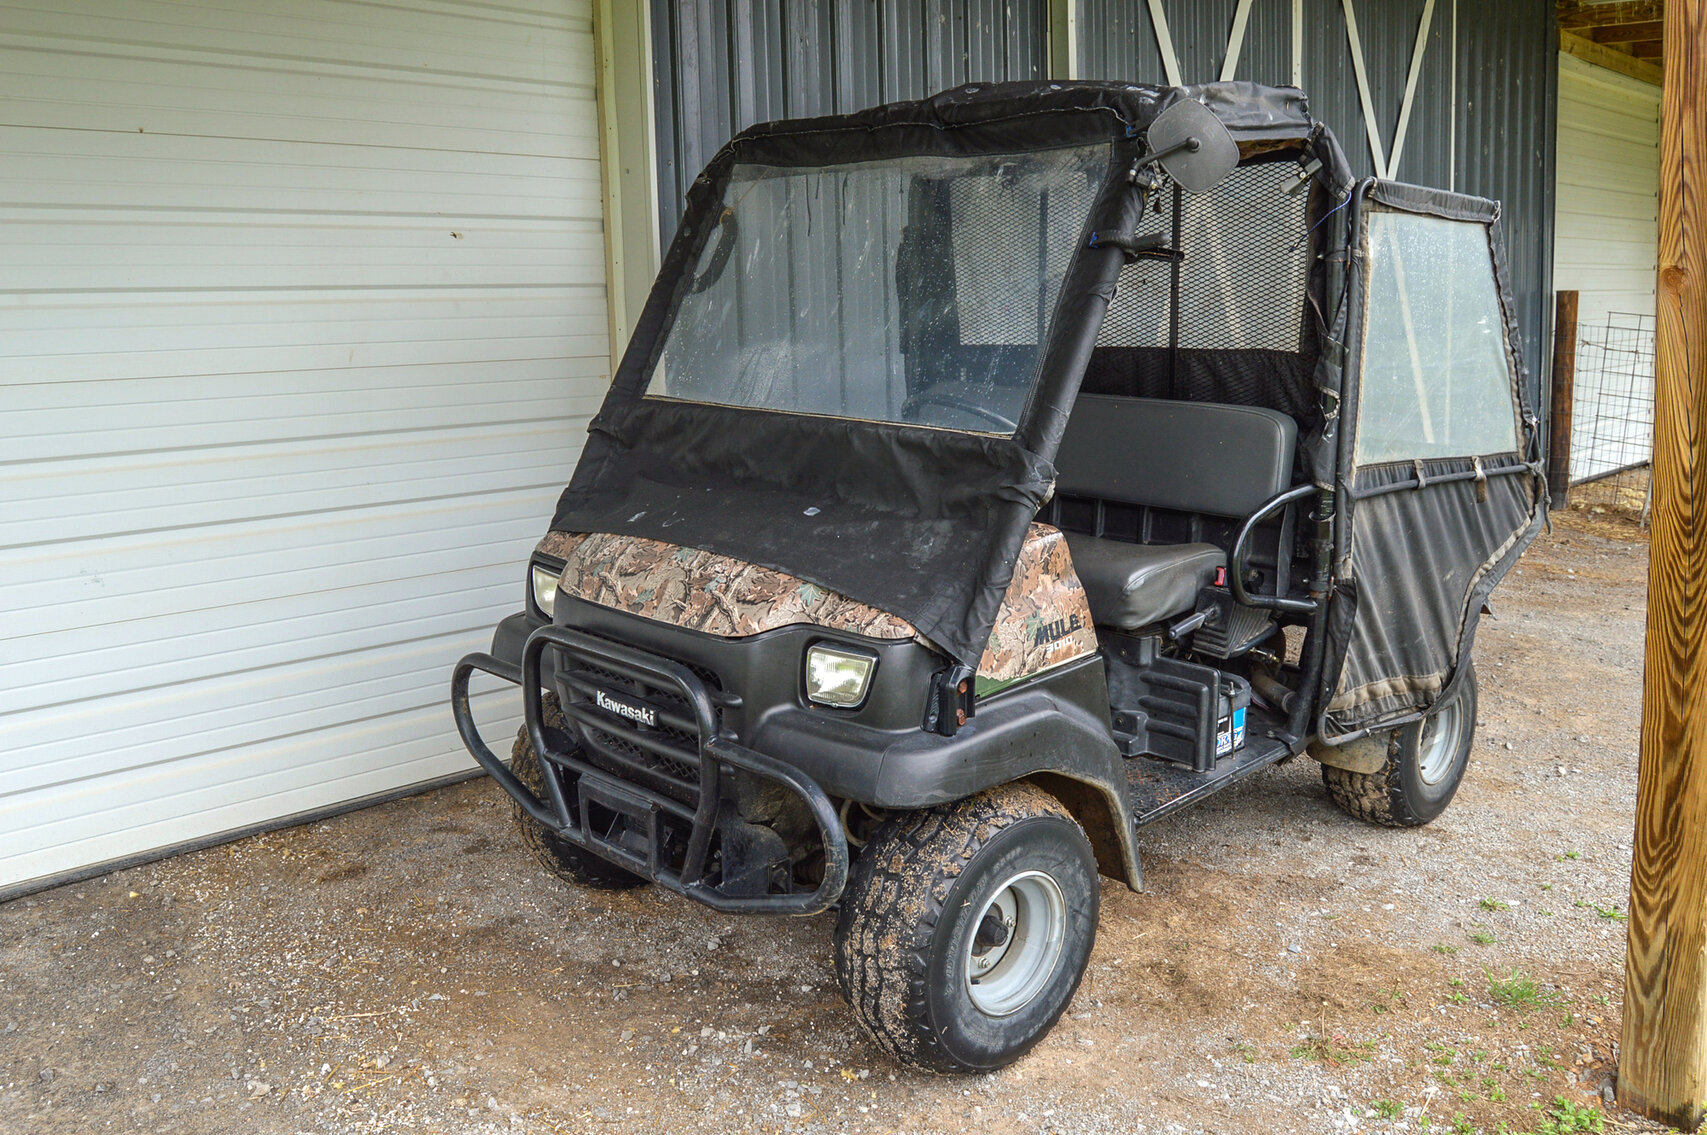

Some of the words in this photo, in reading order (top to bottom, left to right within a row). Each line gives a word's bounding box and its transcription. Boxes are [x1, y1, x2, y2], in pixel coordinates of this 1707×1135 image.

[1034, 614, 1082, 647] MULE
[1046, 635, 1073, 653] 3010
[597, 690, 655, 726] Kawasaki
